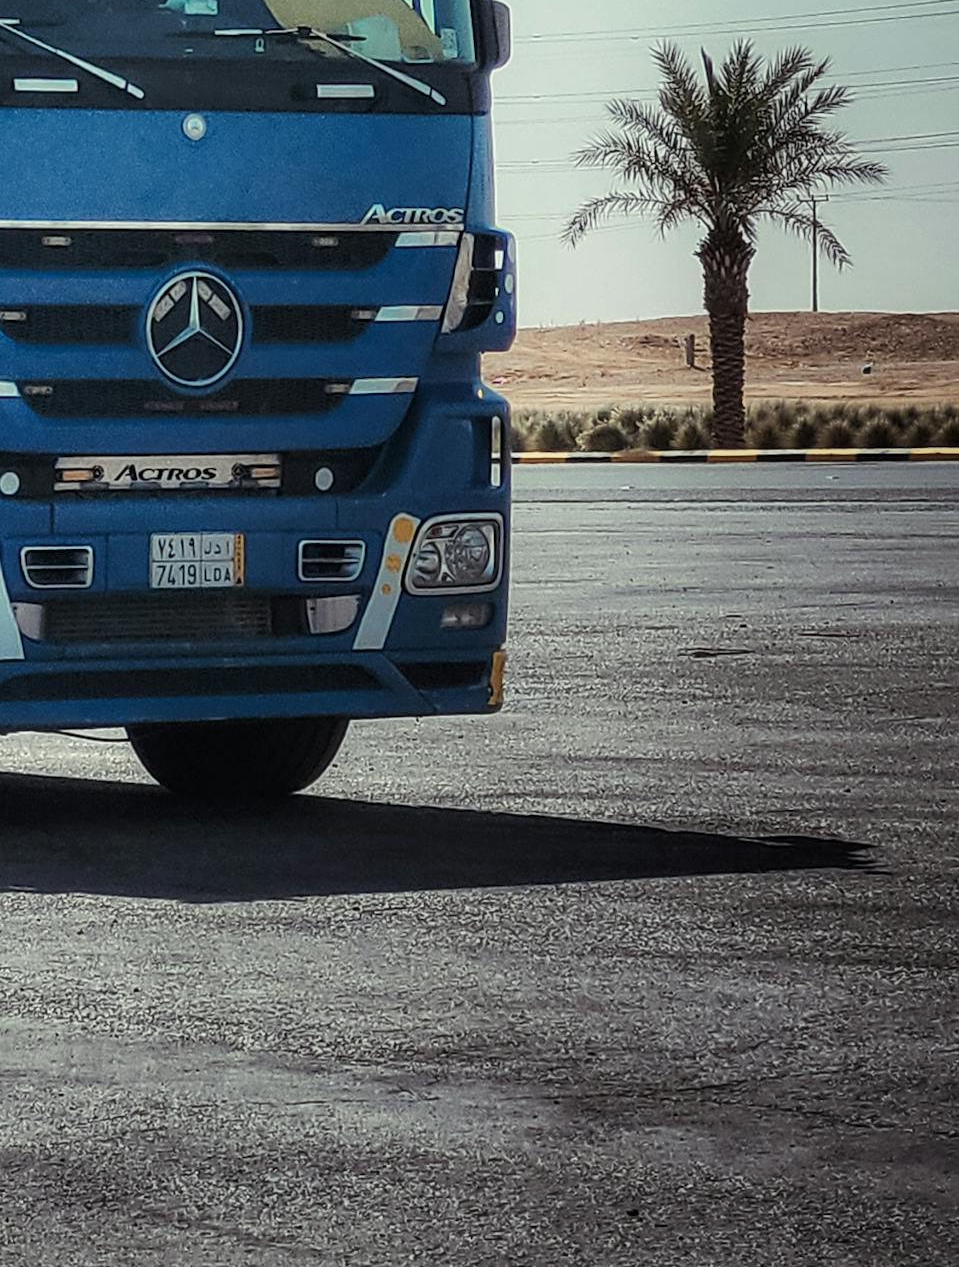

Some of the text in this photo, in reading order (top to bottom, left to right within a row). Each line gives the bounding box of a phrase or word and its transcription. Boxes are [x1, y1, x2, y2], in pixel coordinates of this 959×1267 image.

[360, 203, 464, 224] ACTROS
[114, 464, 217, 481] ACTROS
[156, 564, 231, 586] 7419 LDA
